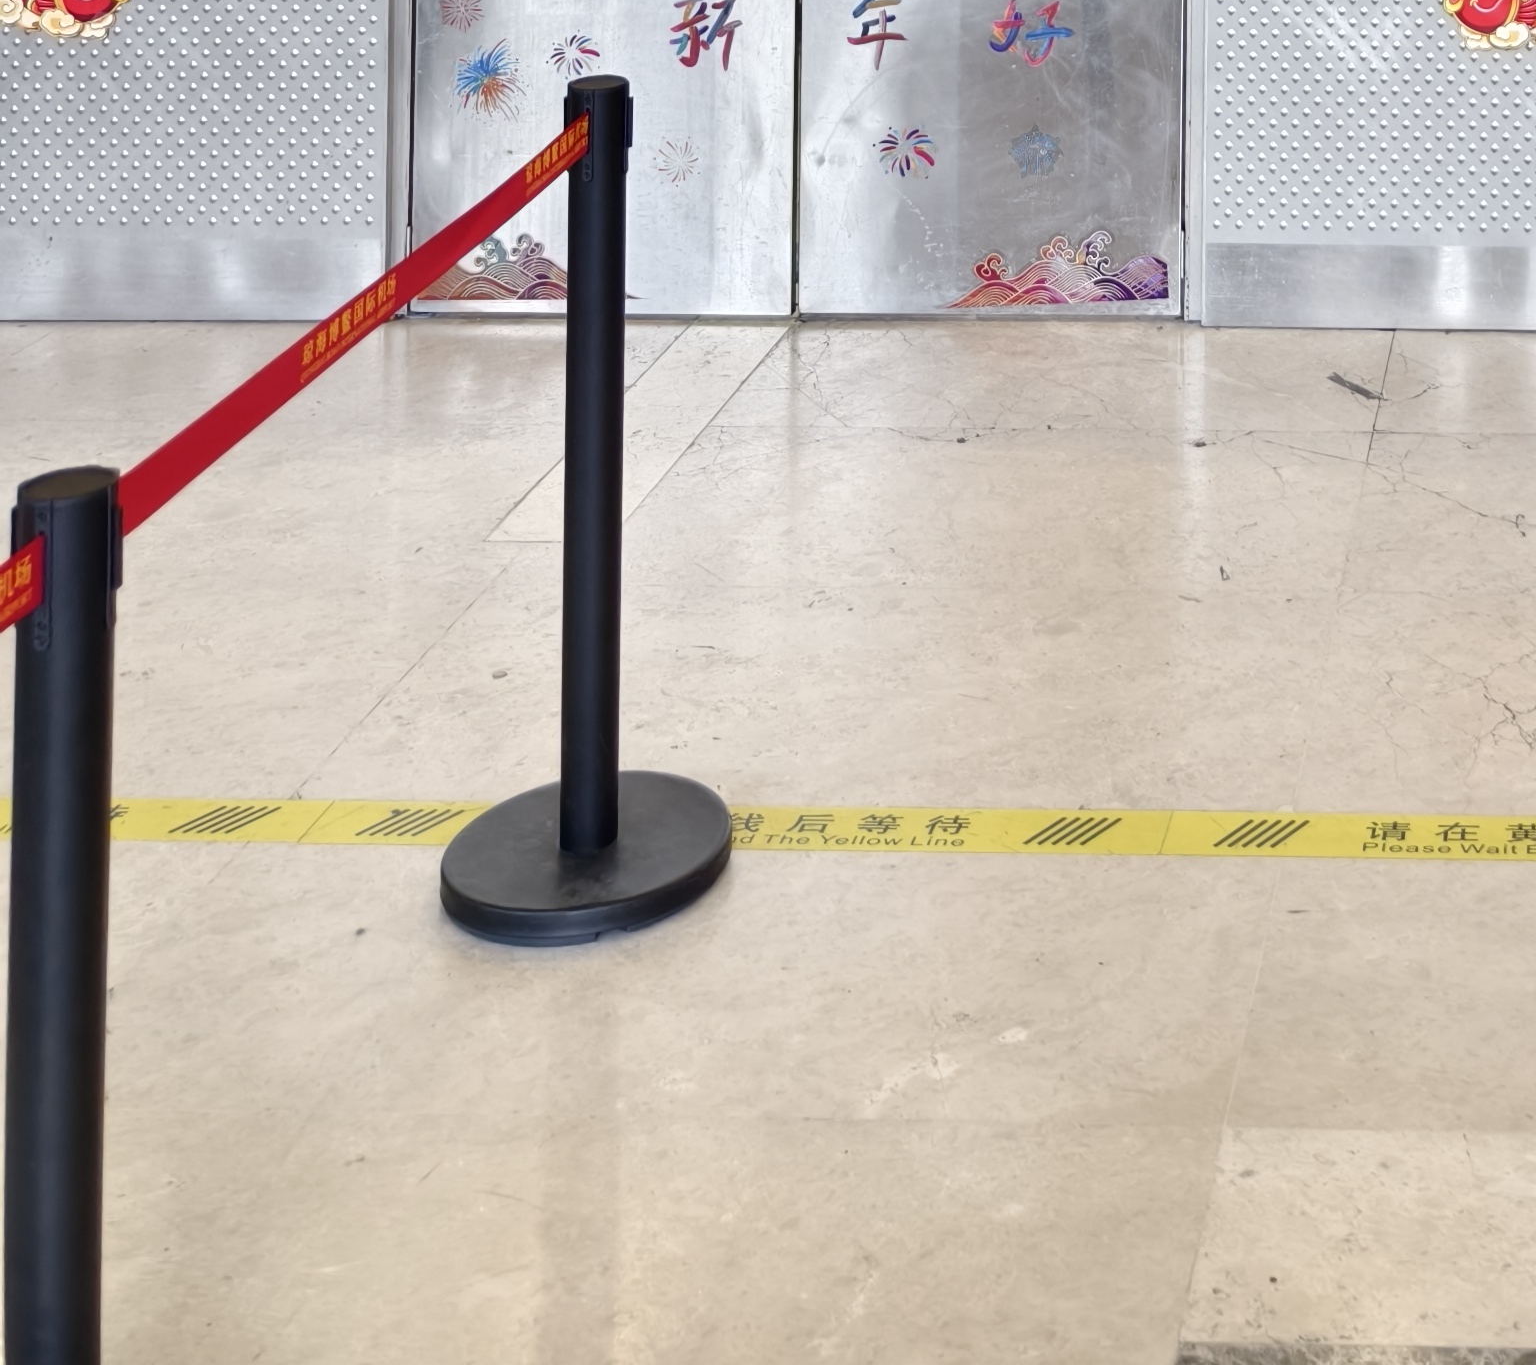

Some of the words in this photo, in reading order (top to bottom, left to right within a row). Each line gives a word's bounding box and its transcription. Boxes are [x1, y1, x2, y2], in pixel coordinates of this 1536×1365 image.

[764, 834, 811, 846] The
[820, 834, 904, 846] Yellow
[909, 835, 966, 847] Line
[1362, 841, 1452, 854] Please
[1460, 843, 1518, 855] Wait
